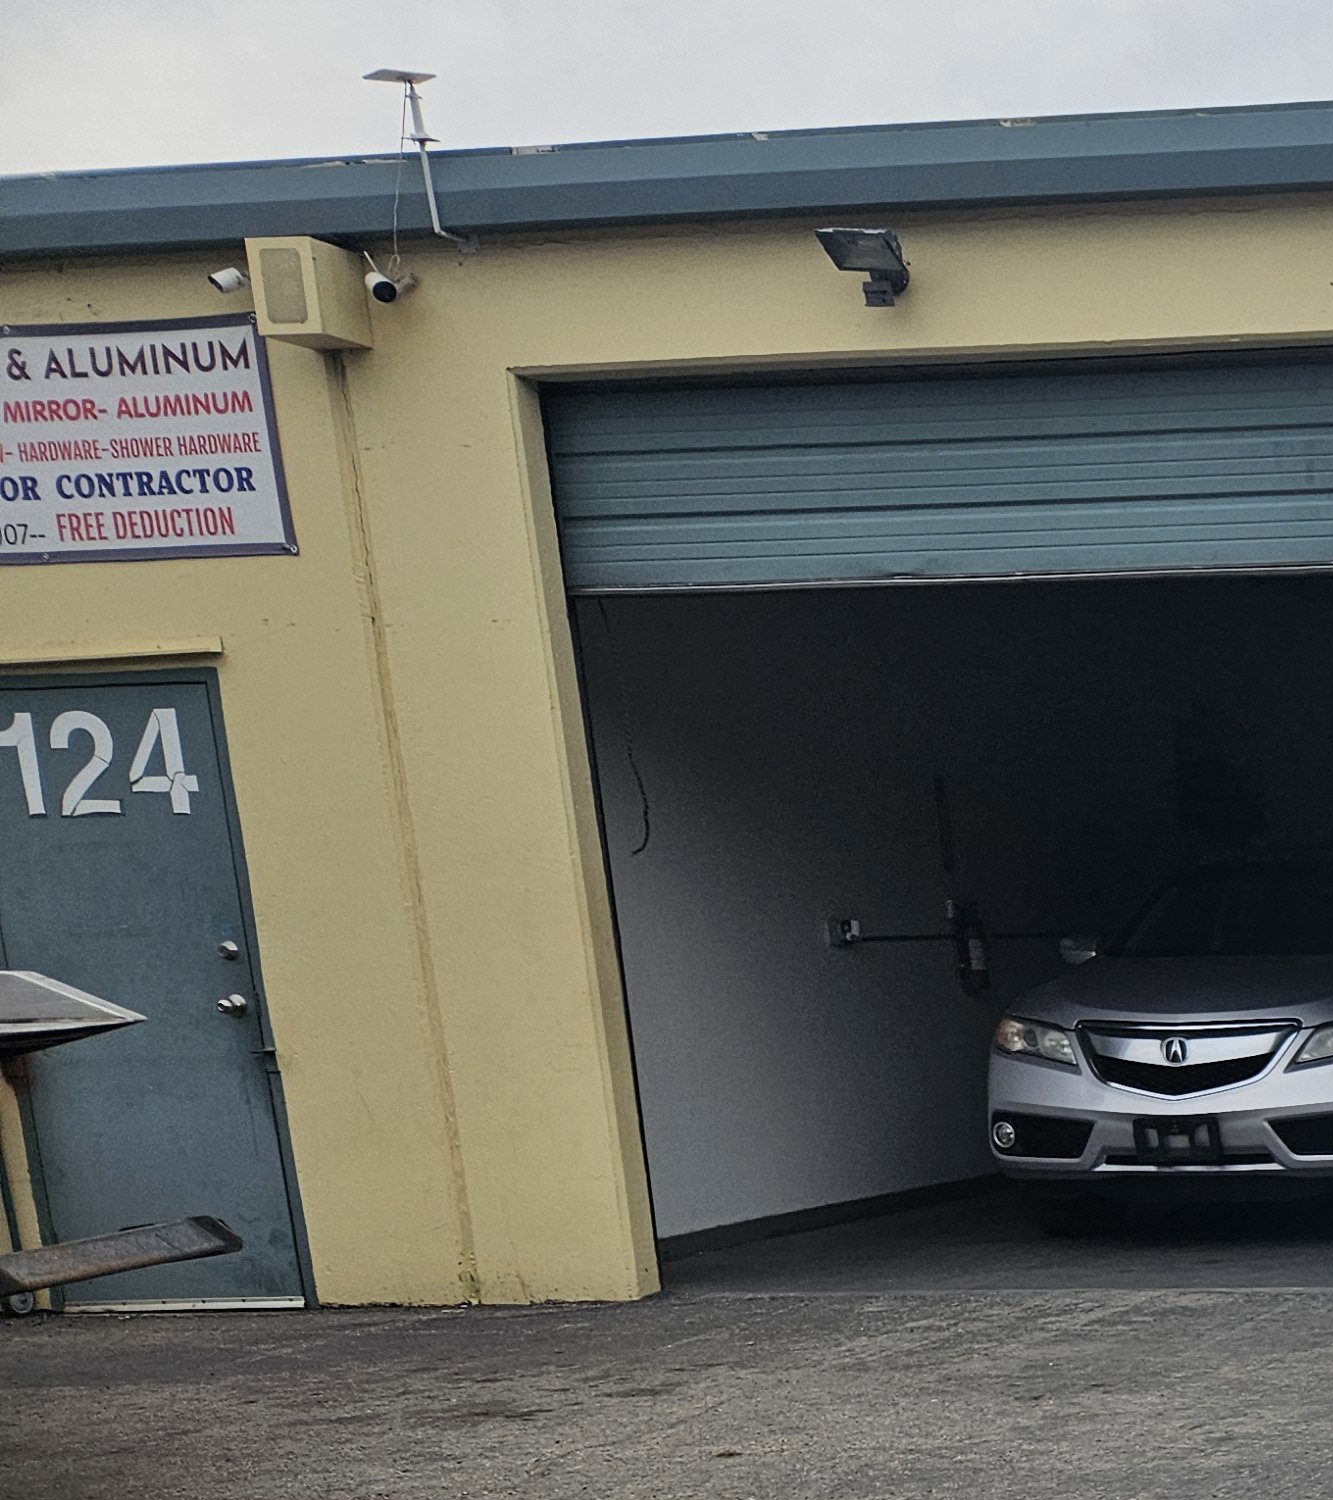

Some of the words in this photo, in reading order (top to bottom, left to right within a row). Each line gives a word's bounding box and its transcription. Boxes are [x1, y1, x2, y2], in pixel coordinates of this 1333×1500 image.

[6, 348, 31, 381] &
[44, 337, 251, 380] ALUMINUM
[3, 398, 108, 424] MIRROR-
[117, 389, 254, 420] ALUMINUM
[177, 431, 262, 457] HARDWARE
[55, 466, 257, 500] CONTRACTOR
[0, 523, 46, 546] 07--
[55, 511, 109, 543] FREE
[112, 506, 237, 540] DEDUCTION
[0, 707, 200, 817] 124
